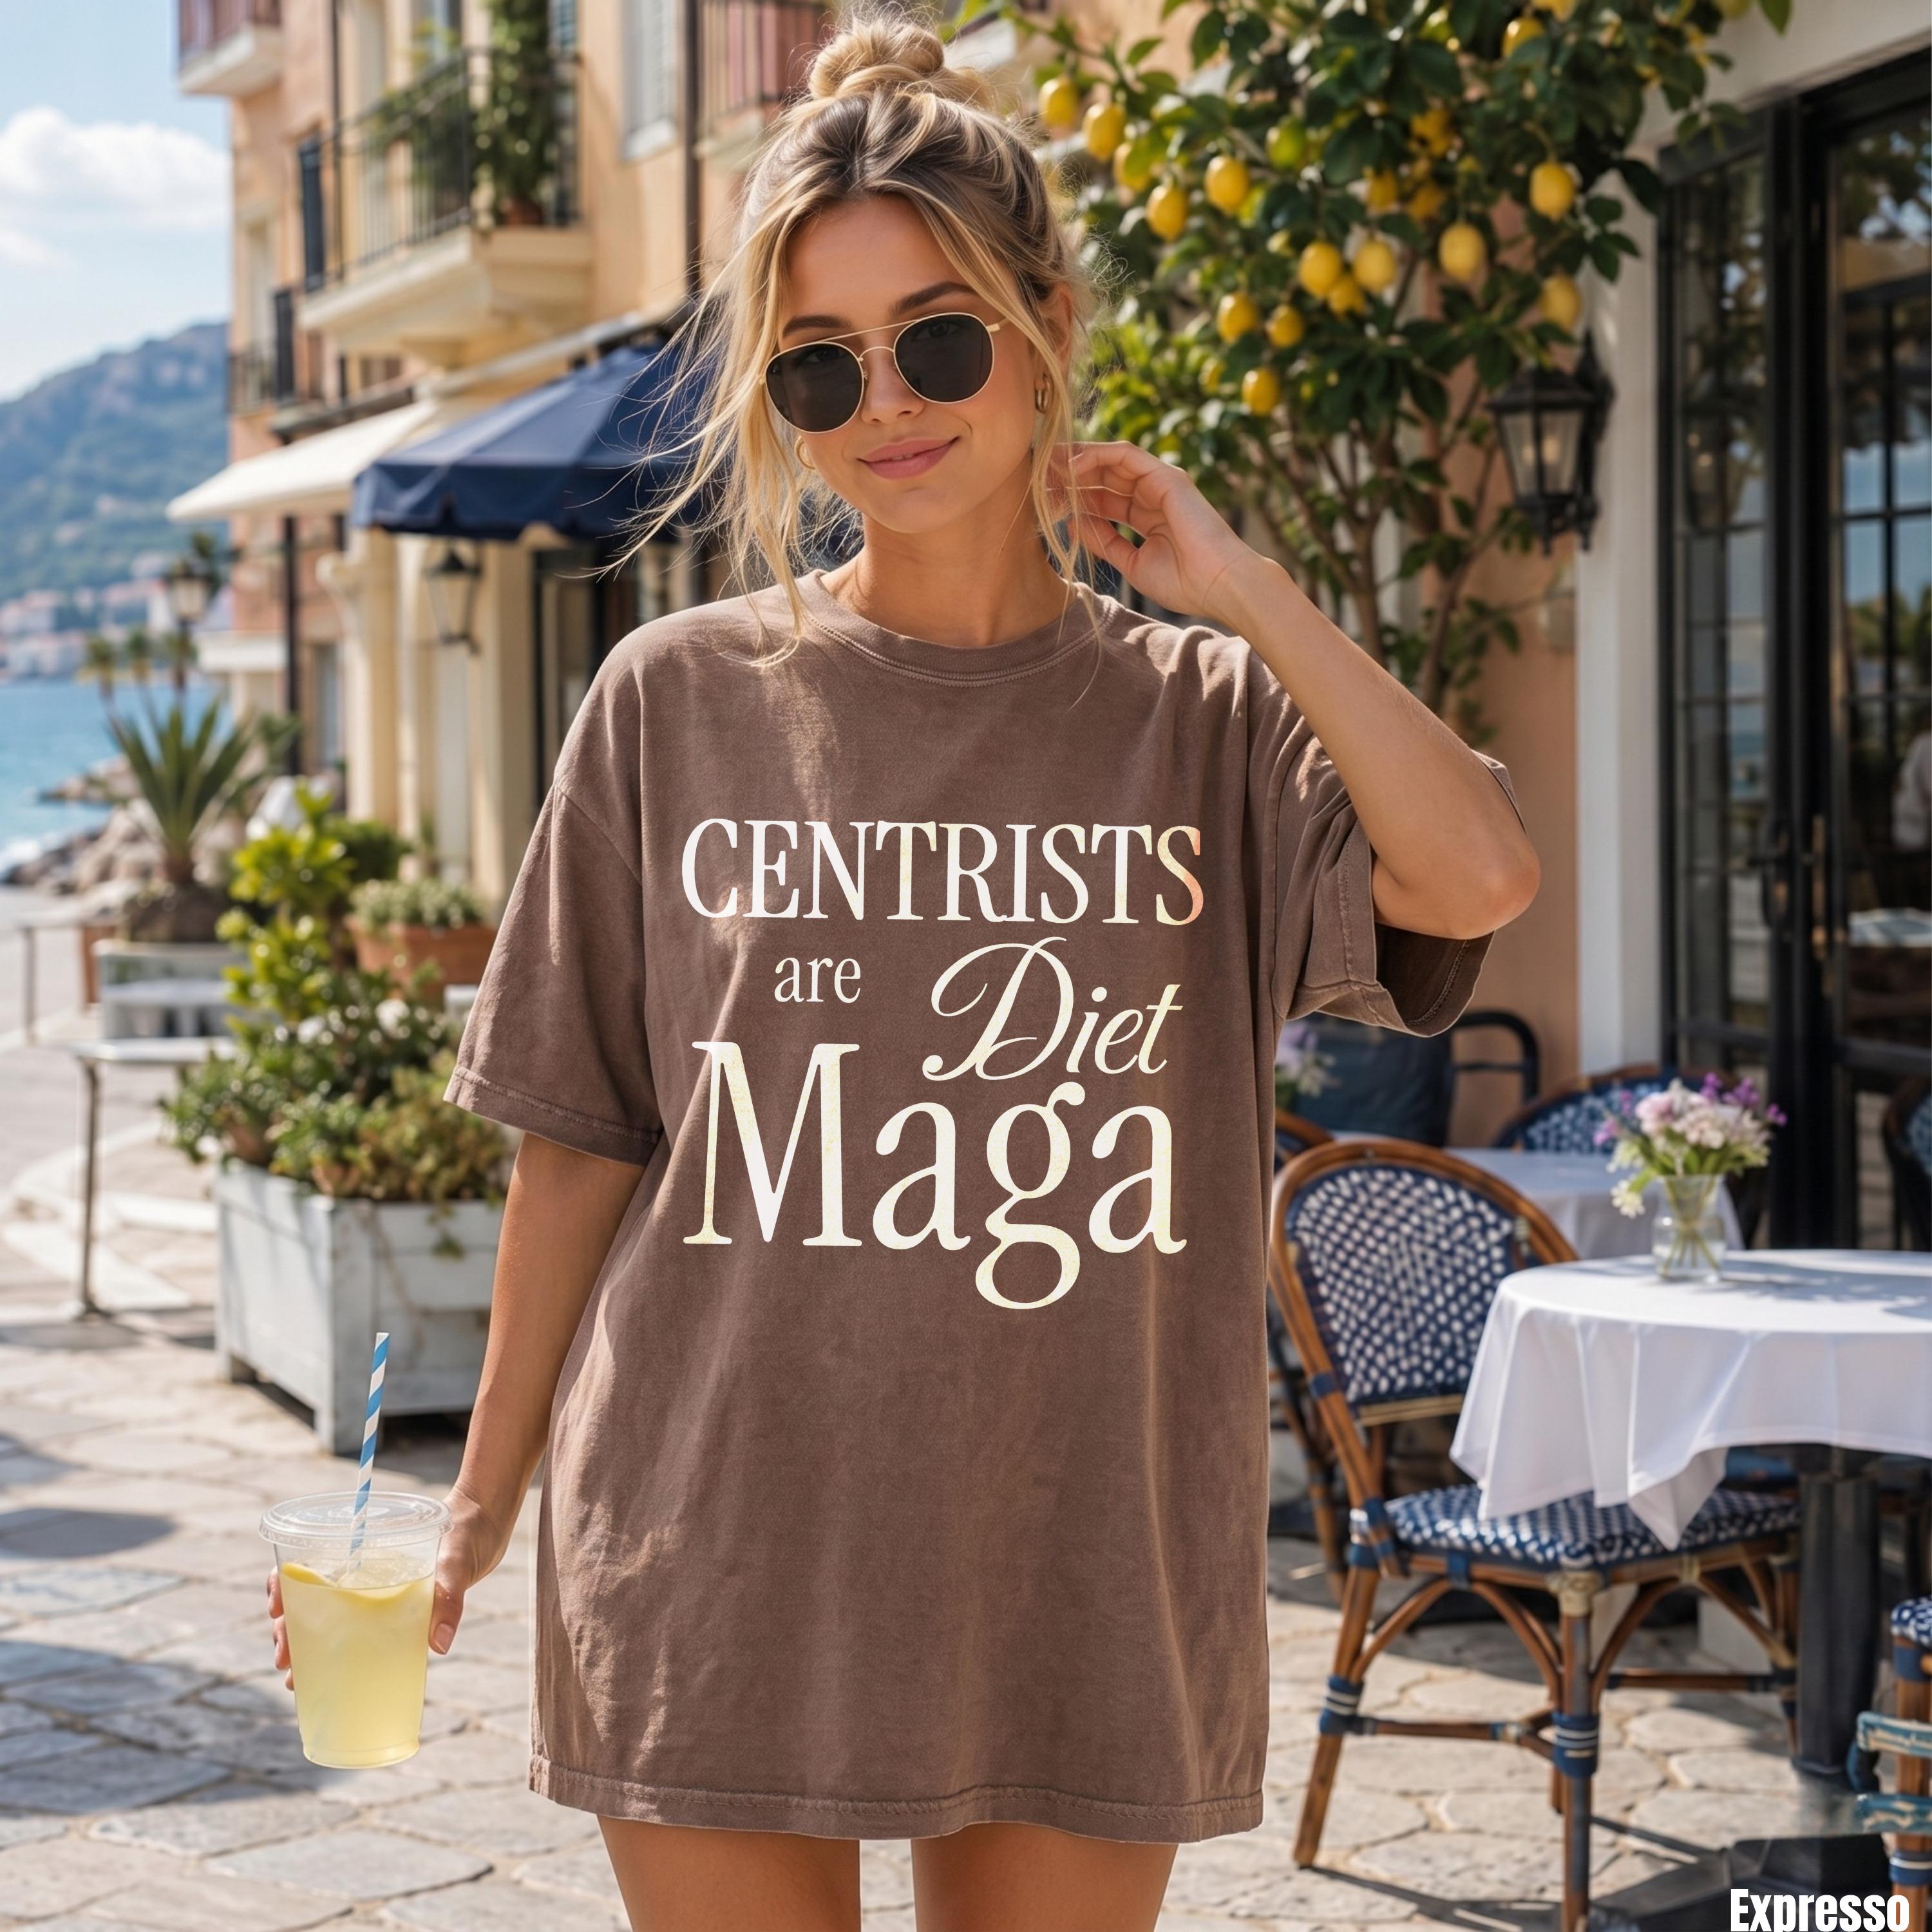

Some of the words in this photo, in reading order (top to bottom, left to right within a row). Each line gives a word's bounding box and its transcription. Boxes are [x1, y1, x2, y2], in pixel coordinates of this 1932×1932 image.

[681, 818, 1204, 925] CENTRISTS
[774, 958, 862, 1003] are
[922, 937, 1184, 1081] Diet
[683, 1041, 1188, 1310] Maga
